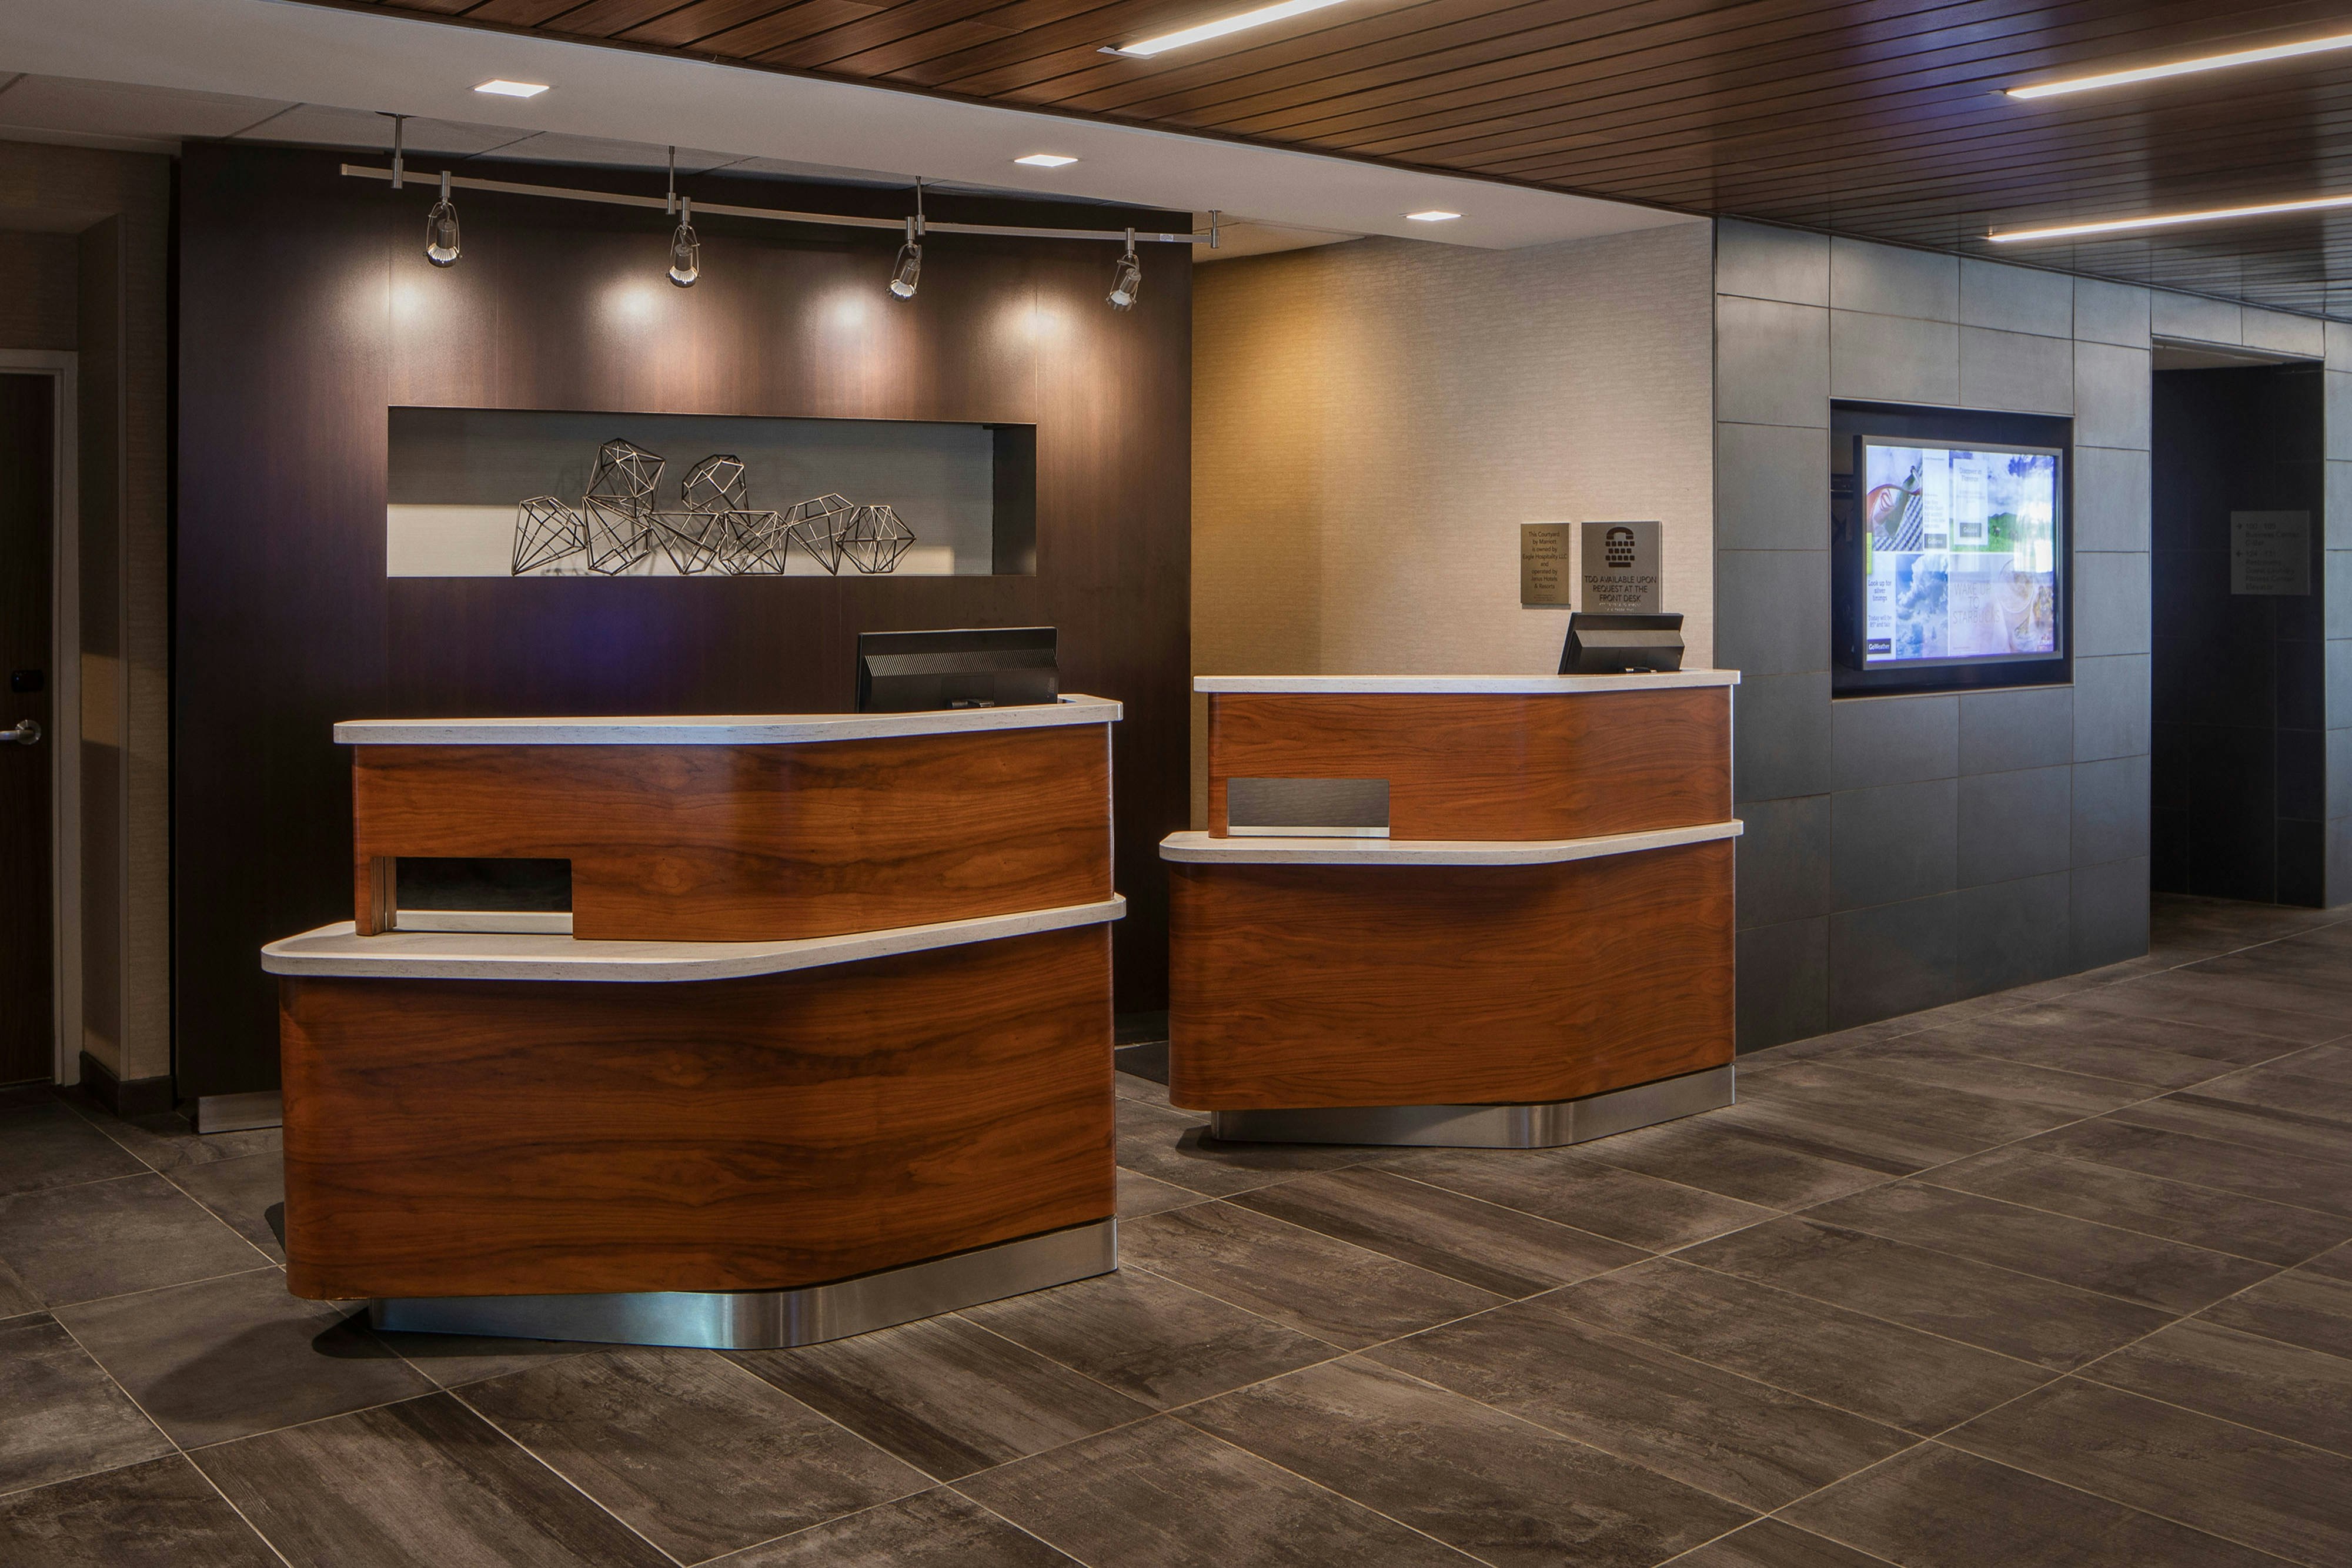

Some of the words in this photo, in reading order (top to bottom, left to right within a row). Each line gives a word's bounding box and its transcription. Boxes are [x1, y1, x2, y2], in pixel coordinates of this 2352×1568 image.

[1636, 576, 1657, 584] UPON
[1635, 585, 1648, 593] THE
[1954, 583, 1976, 596] WAKE
[1980, 583, 1991, 595] UP
[1968, 596, 1979, 610] TO
